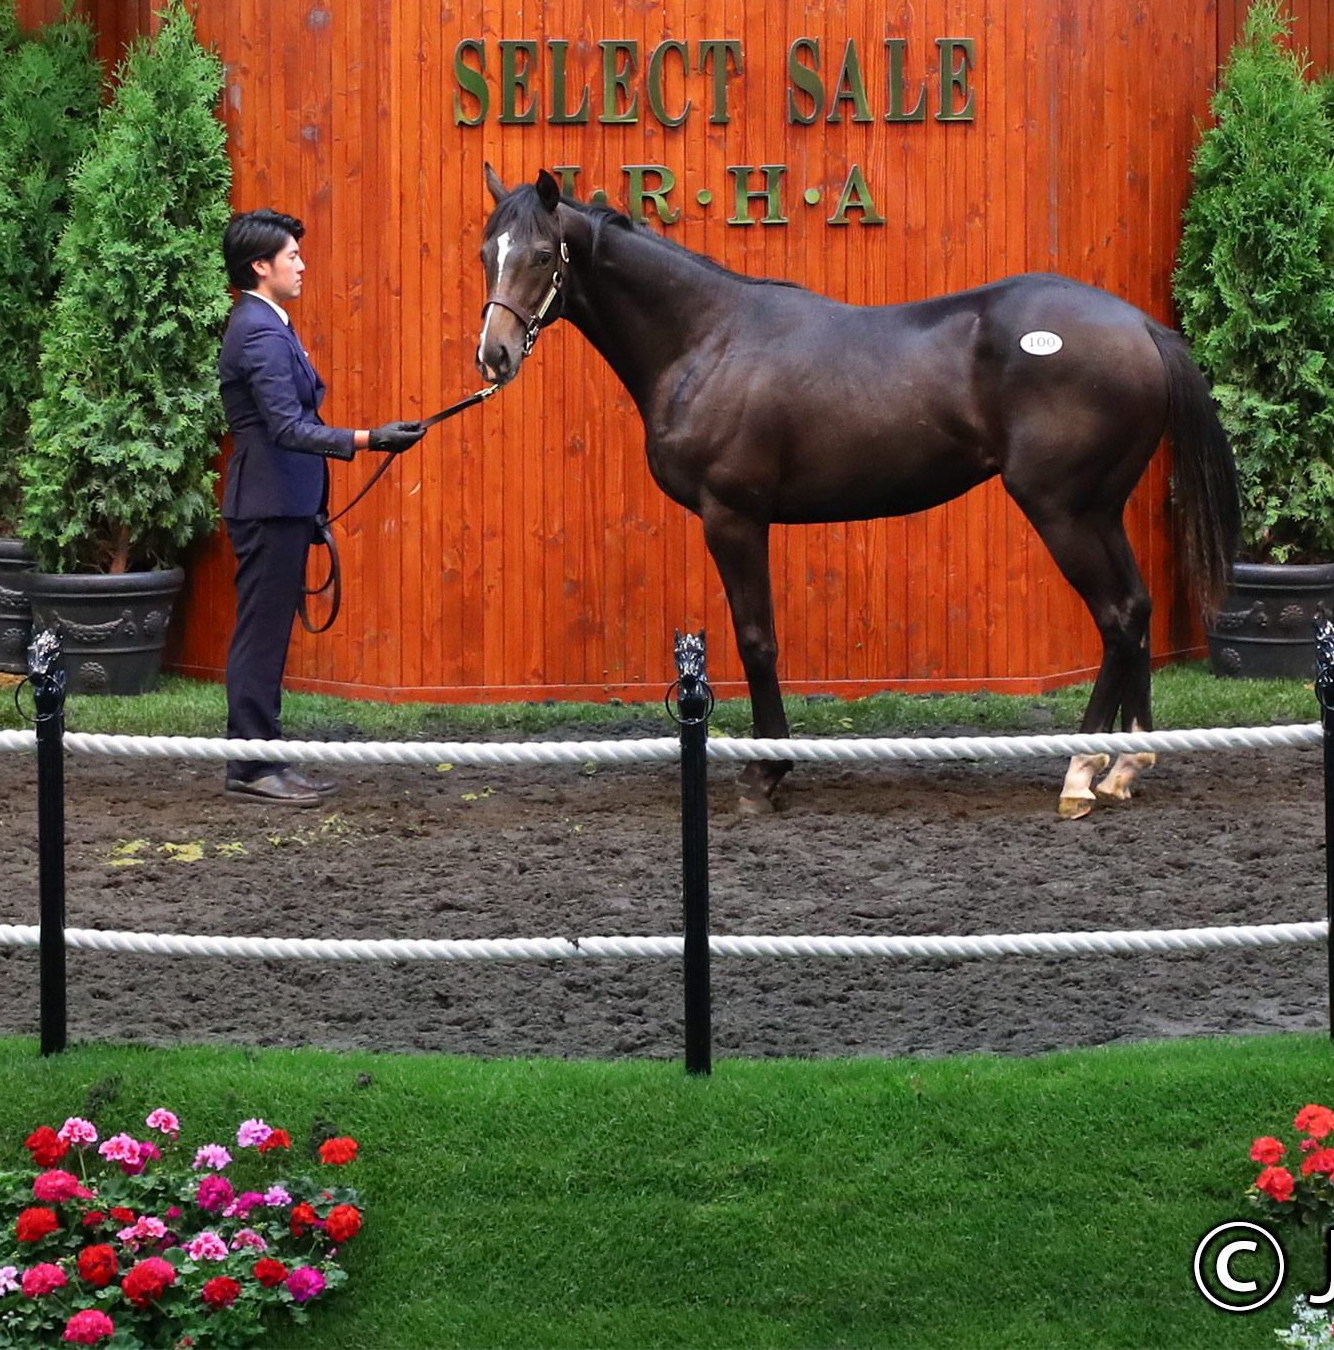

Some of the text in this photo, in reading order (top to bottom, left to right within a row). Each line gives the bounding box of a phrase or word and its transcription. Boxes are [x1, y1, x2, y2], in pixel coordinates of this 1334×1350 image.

[454, 36, 975, 127] SELECT SALE
[1029, 336, 1056, 348] 100
